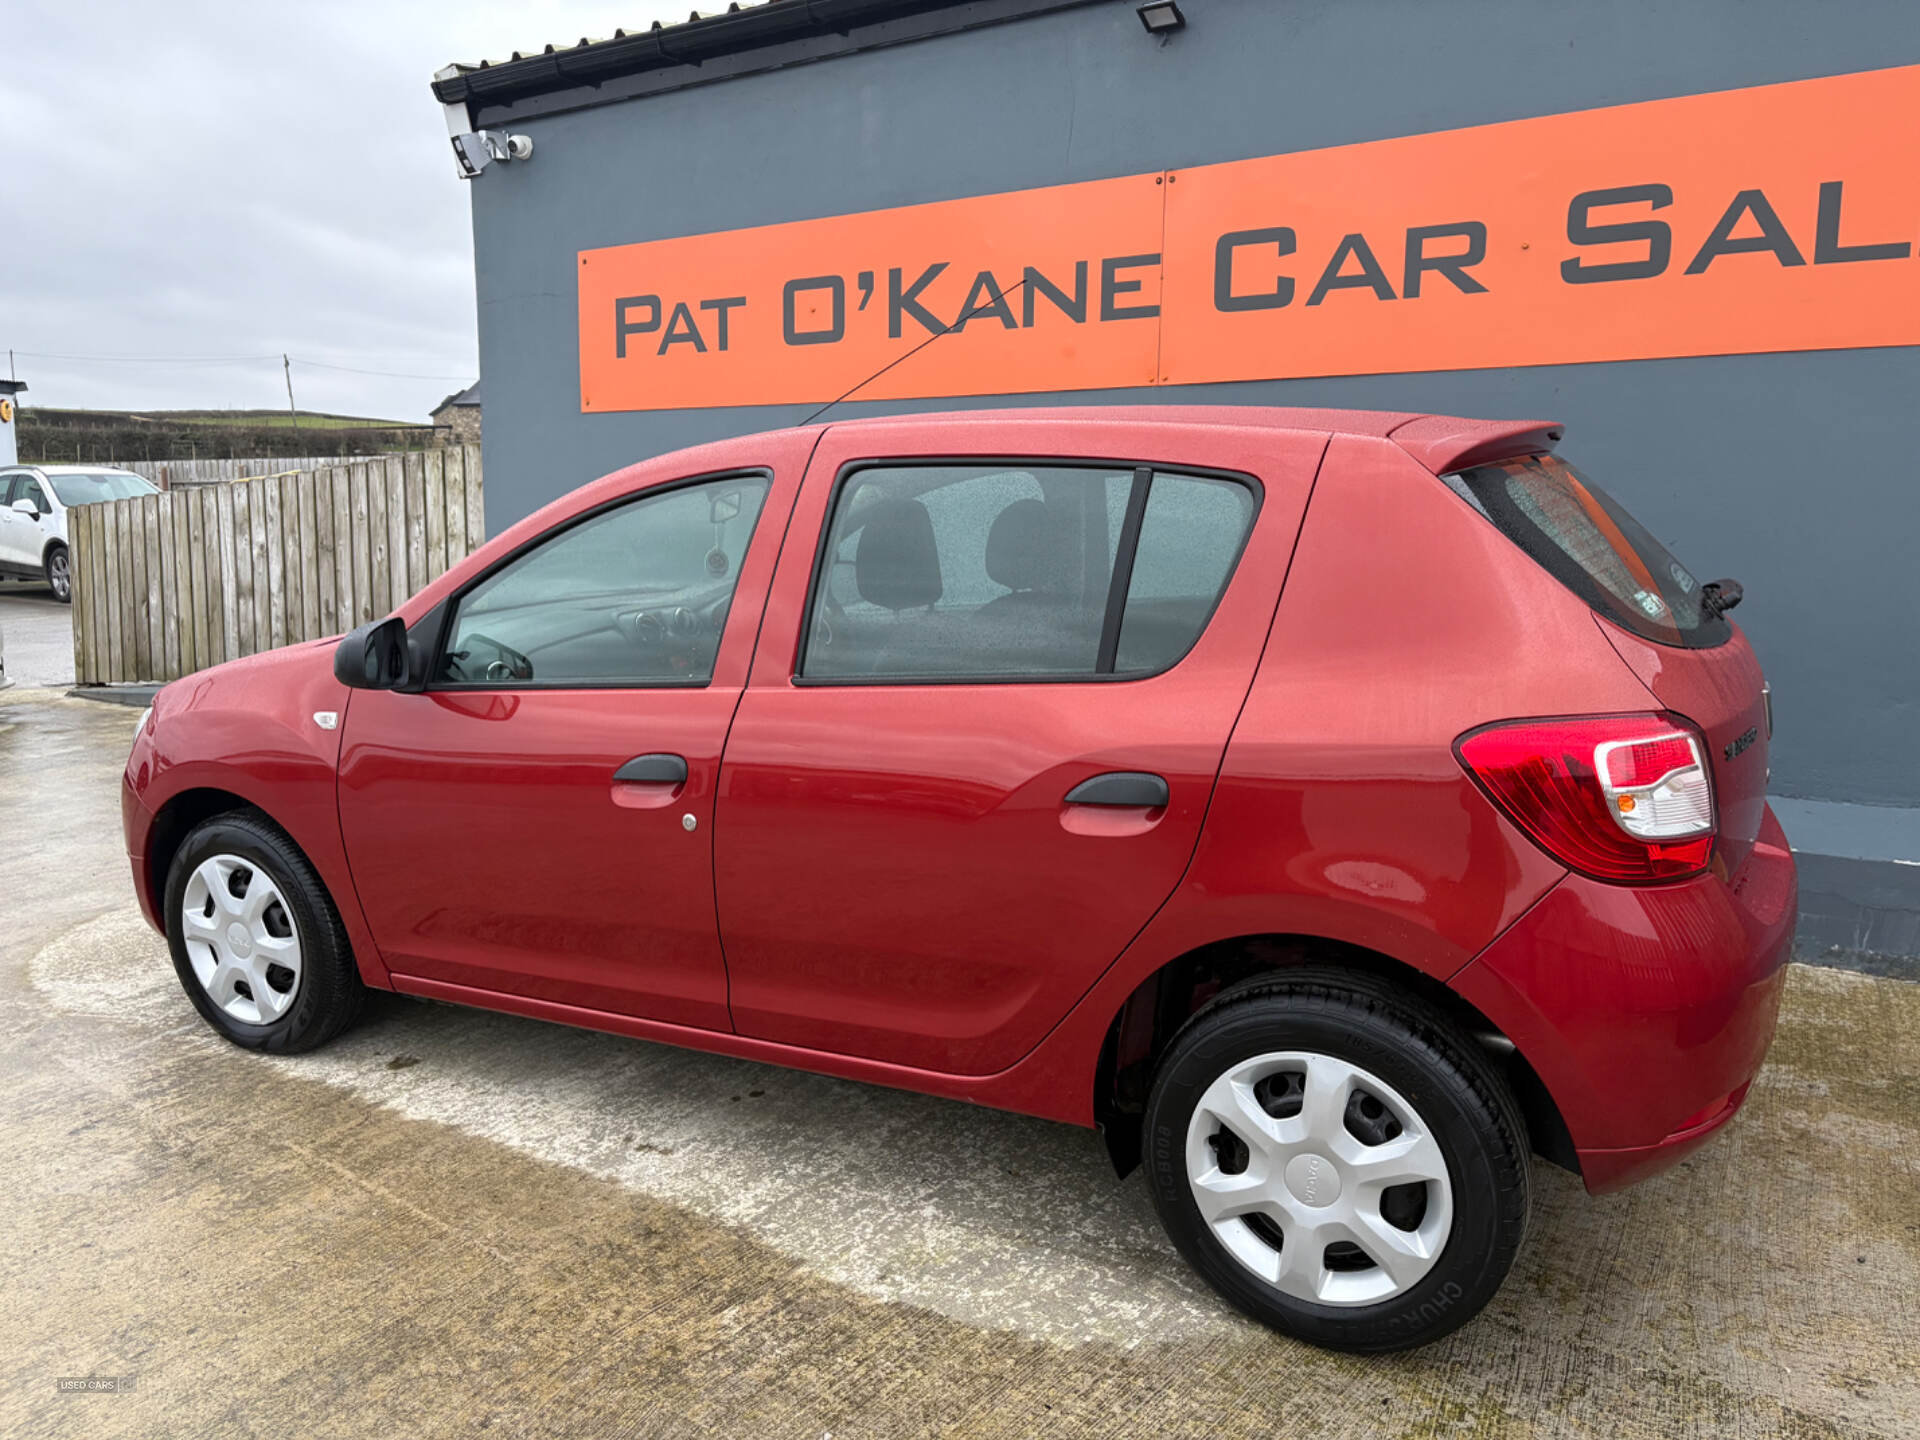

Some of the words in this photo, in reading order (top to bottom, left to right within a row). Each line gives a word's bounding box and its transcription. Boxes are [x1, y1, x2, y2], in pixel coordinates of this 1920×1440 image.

[615, 295, 746, 359] PAT
[783, 253, 1161, 346] O'KANE
[1214, 221, 1488, 313] CAR
[1561, 181, 1920, 285] SAL
